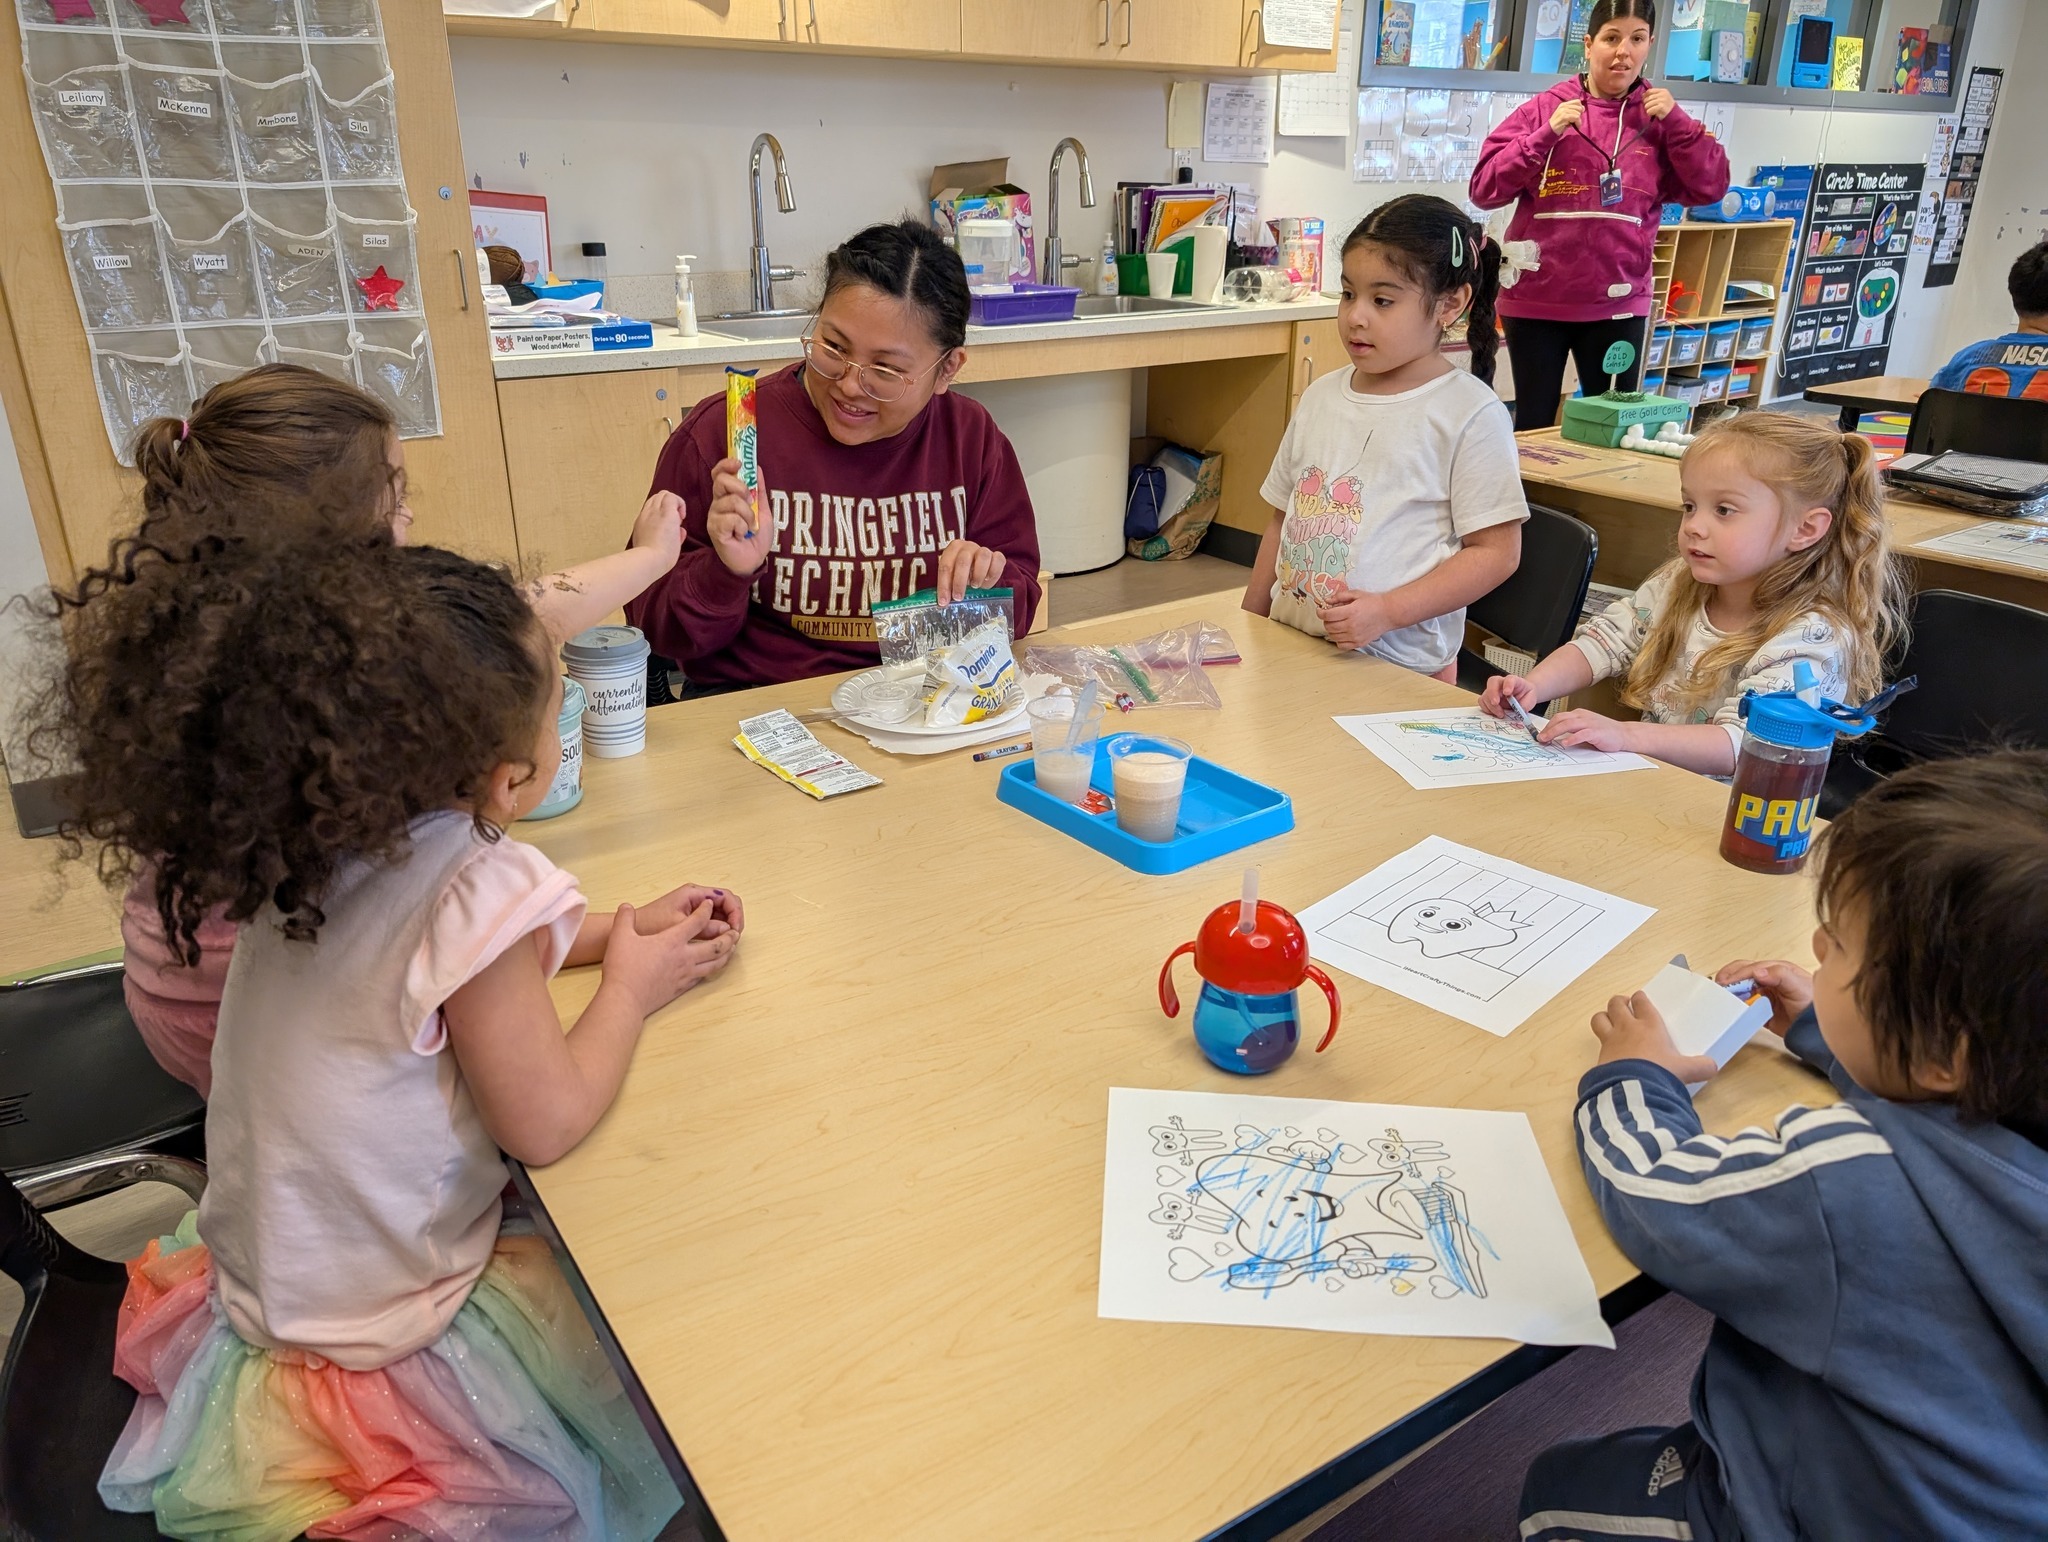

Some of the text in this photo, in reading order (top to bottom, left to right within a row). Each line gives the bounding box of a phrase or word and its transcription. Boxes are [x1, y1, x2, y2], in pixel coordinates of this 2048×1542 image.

[1921, 78, 1948, 93] COLORS
[61, 93, 104, 105] Leiliany
[160, 99, 208, 114] McKenna
[350, 121, 368, 132] Sila
[1421, 113, 1430, 137] 2
[1465, 115, 1472, 137] 3
[1713, 121, 1723, 141] 10
[1826, 172, 1908, 190] Circle Time Center
[365, 236, 387, 246] Silas
[297, 247, 323, 256] ADEN
[95, 257, 128, 268] Willow
[194, 257, 225, 269] Wyatt
[1836, 314, 1848, 322] Shape
[517, 335, 534, 343] Paint
[615, 333, 628, 343] 90
[531, 341, 580, 351] Wood and More!
[1607, 352, 1627, 360] GOLD
[1640, 407, 1658, 419] Gold
[1662, 405, 1682, 416] Coins
[740, 425, 757, 487] Mamba
[770, 486, 967, 557] PRINGFIELD
[752, 556, 927, 617] ECHNIC
[796, 619, 872, 638] COMMUNITY
[957, 644, 997, 683] Domino
[592, 678, 643, 700] currently
[590, 695, 645, 716] affeinating
[562, 741, 582, 763] SOU
[995, 745, 1019, 755] CRAYONS
[1402, 965, 1482, 1001] iHeartCraftyThings.com
[1647, 1446, 1677, 1497] adidas
